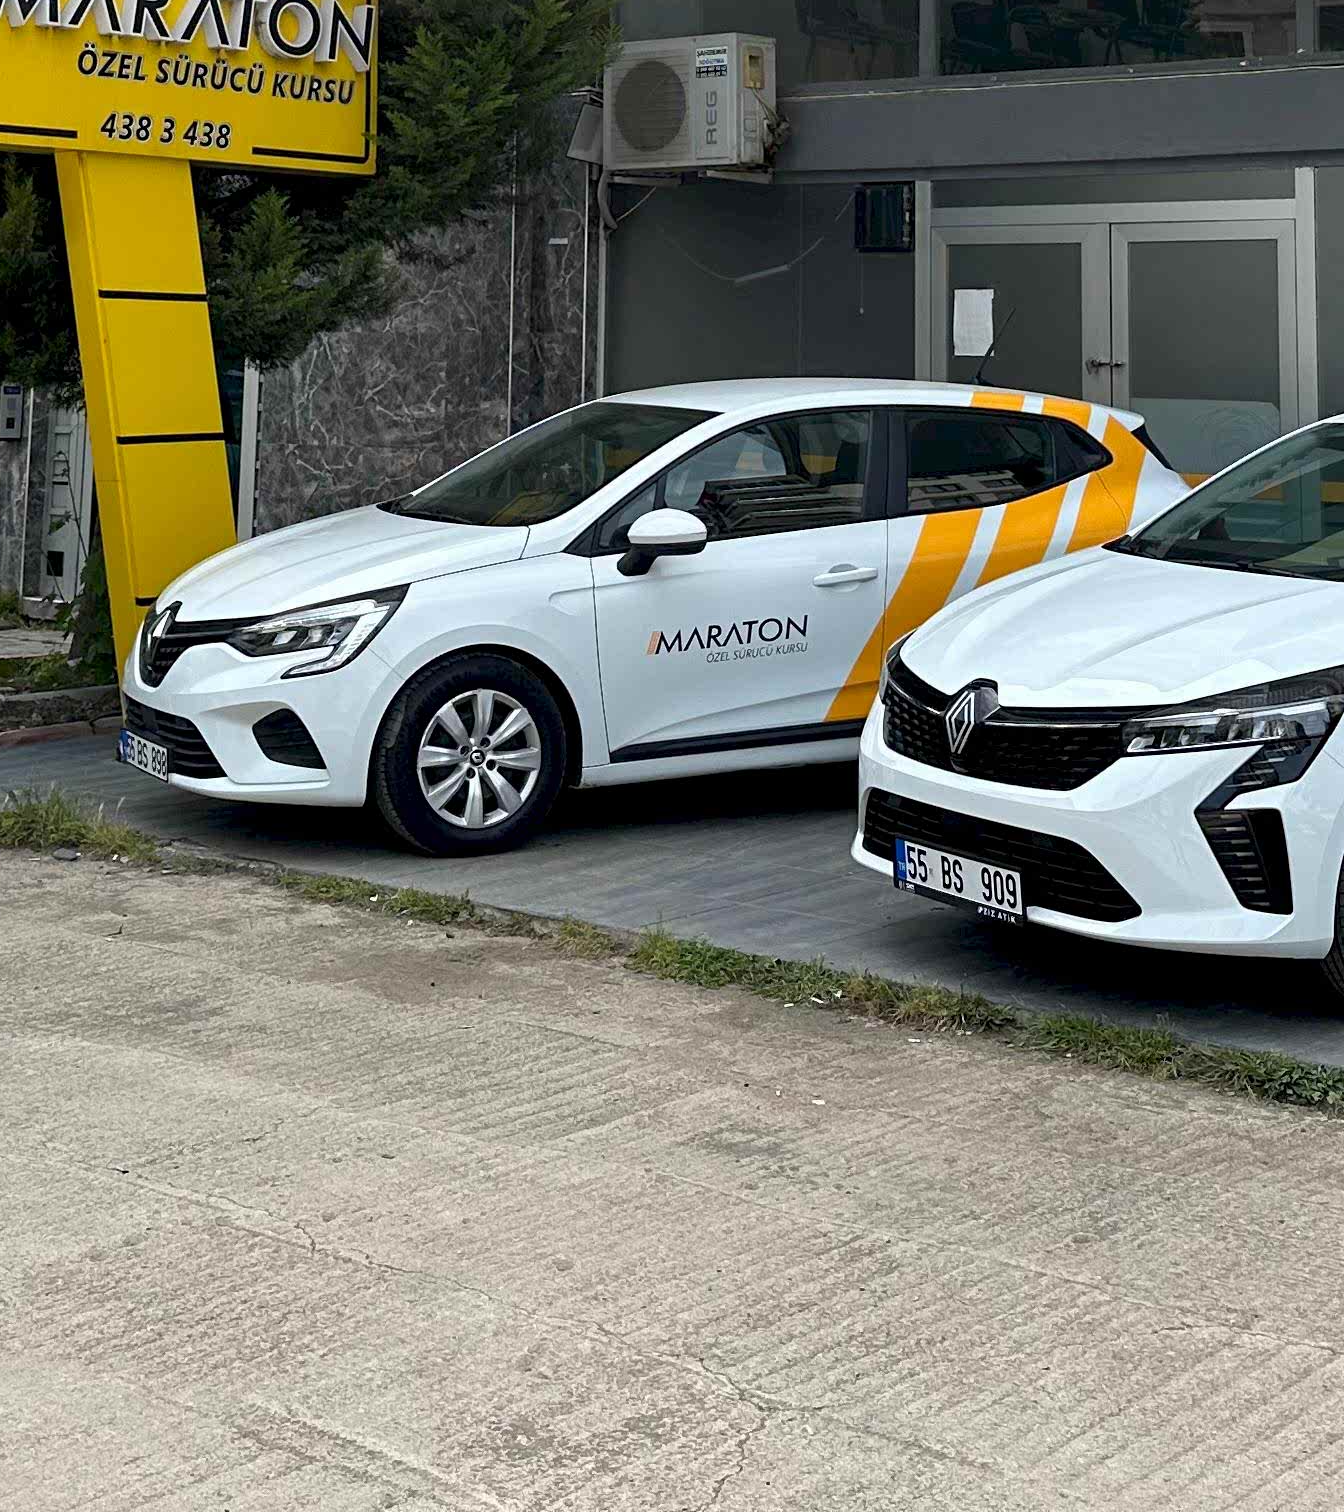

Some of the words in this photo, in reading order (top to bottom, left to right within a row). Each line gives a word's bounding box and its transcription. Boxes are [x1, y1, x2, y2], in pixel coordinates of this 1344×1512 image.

[77, 43, 147, 82] ÖZEL
[155, 56, 266, 95] SÜRÜCÜ
[271, 71, 357, 105] KURSU
[100, 112, 150, 141] 438
[159, 117, 175, 144] 3
[183, 119, 232, 149] 438
[654, 614, 809, 655] MARATON
[137, 739, 149, 769] BS
[906, 845, 928, 883] 55
[941, 855, 964, 894] BS
[981, 866, 1018, 909] 909
